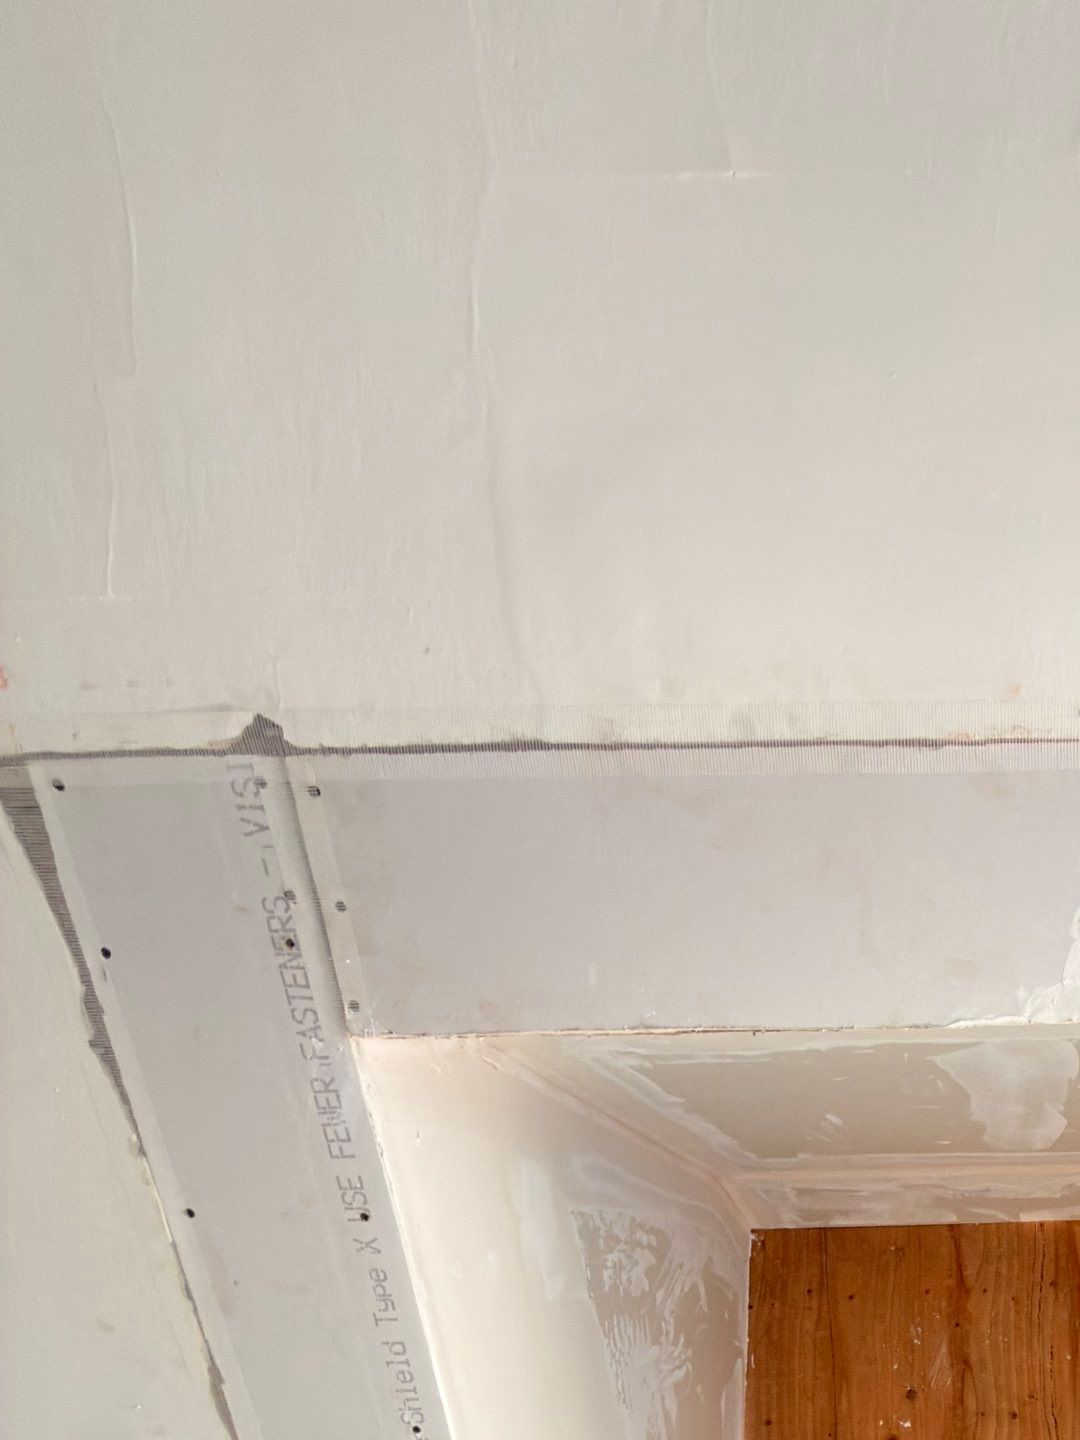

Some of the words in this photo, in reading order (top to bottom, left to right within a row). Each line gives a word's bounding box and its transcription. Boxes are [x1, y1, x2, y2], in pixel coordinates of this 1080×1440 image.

[262, 896, 329, 1060] FASTENERS
[310, 1078, 355, 1159] FEWER
[336, 1176, 371, 1222] USE
[352, 1238, 381, 1254] X
[368, 1268, 398, 1326] Type
